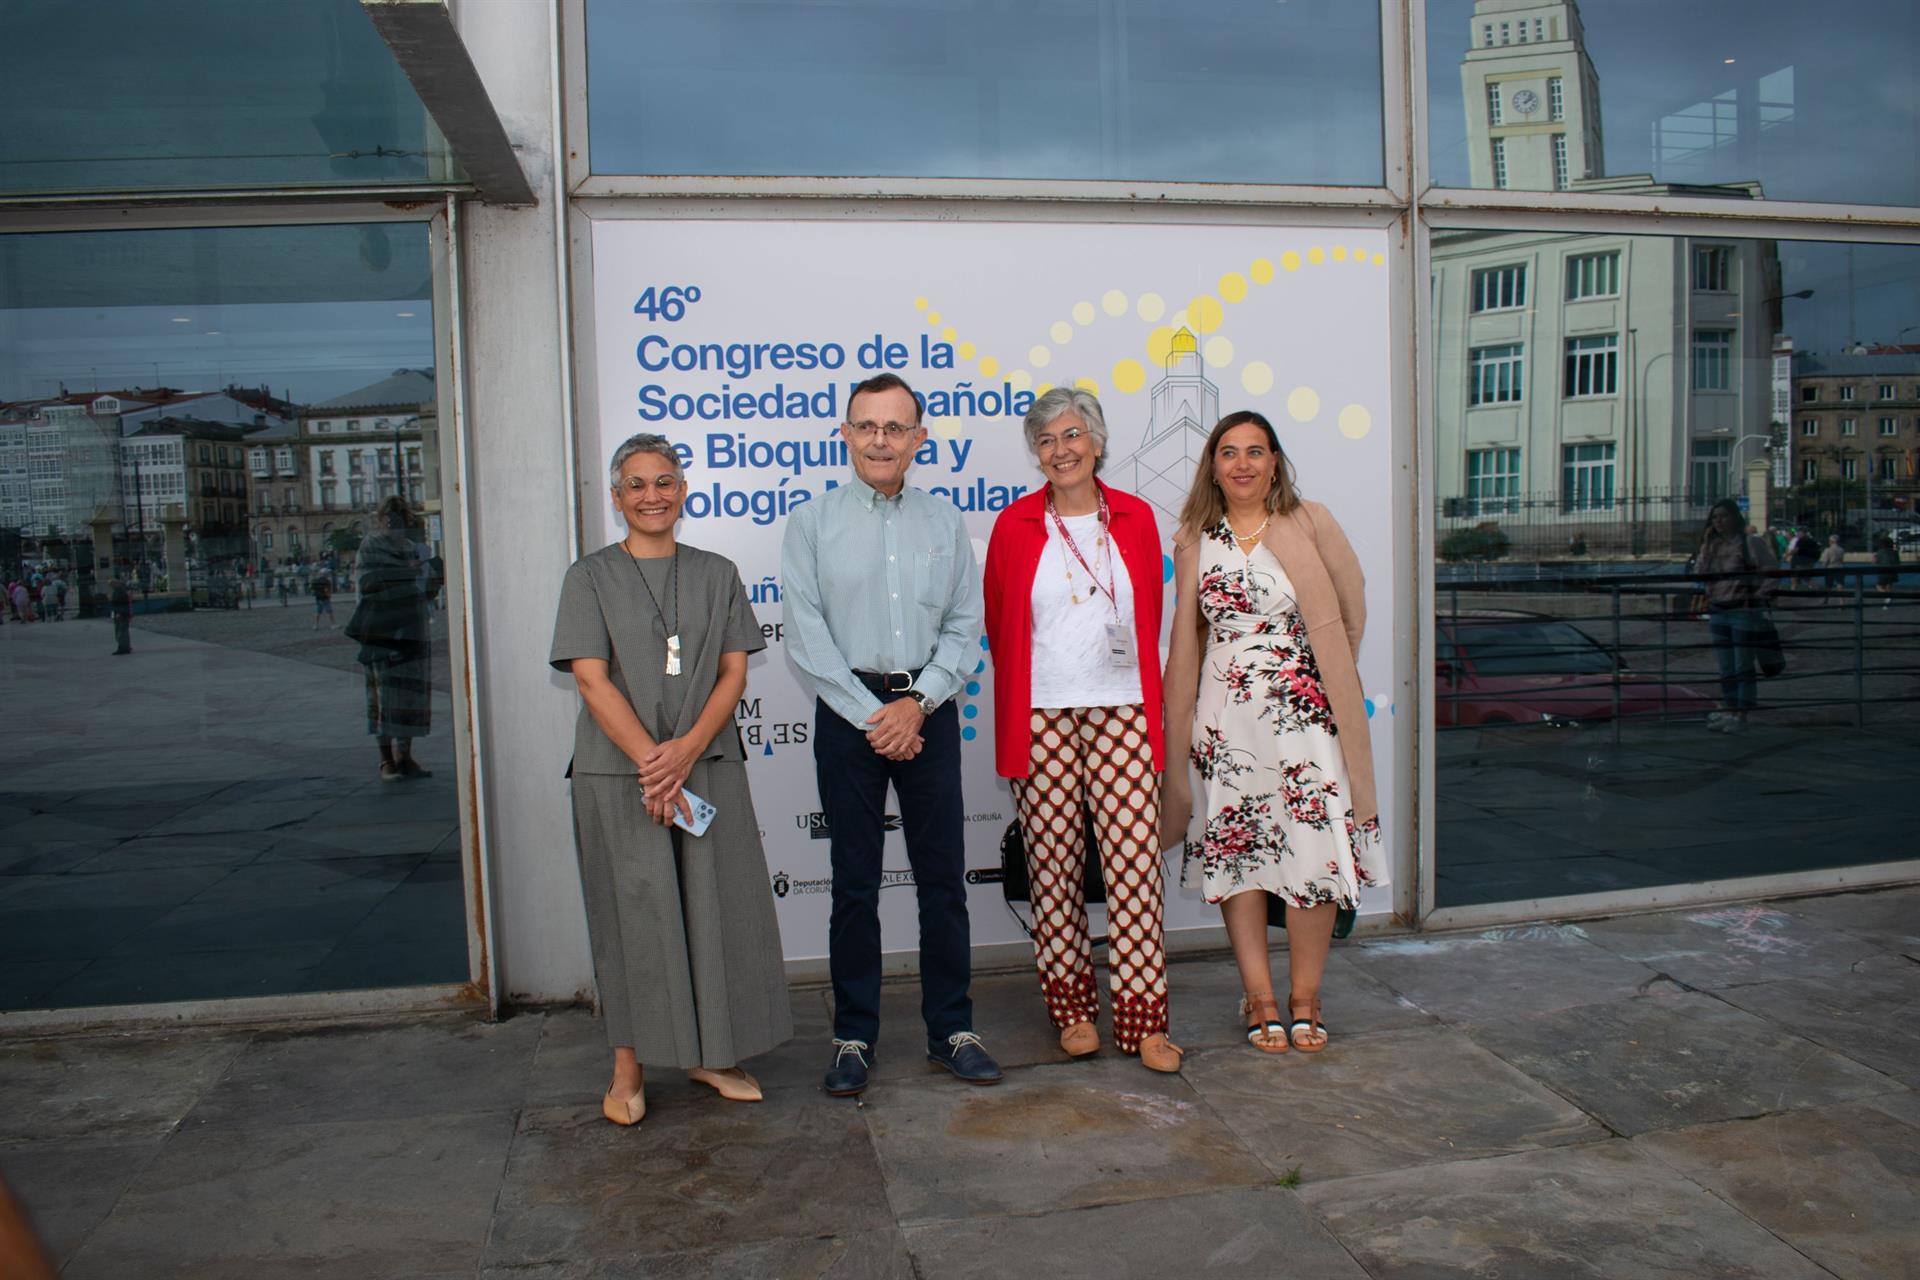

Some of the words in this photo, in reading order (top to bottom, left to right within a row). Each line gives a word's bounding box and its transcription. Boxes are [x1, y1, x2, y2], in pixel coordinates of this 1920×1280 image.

[634, 286, 701, 322] 46º
[636, 334, 845, 379] Congreso
[857, 334, 909, 370] de
[921, 334, 954, 369] la
[638, 383, 837, 421] Sociedad
[851, 381, 1037, 417] añola
[662, 434, 694, 470] e
[706, 428, 938, 476] Bioquía
[948, 439, 973, 473] y
[678, 477, 812, 526] ología
[793, 877, 832, 889] Deputació
